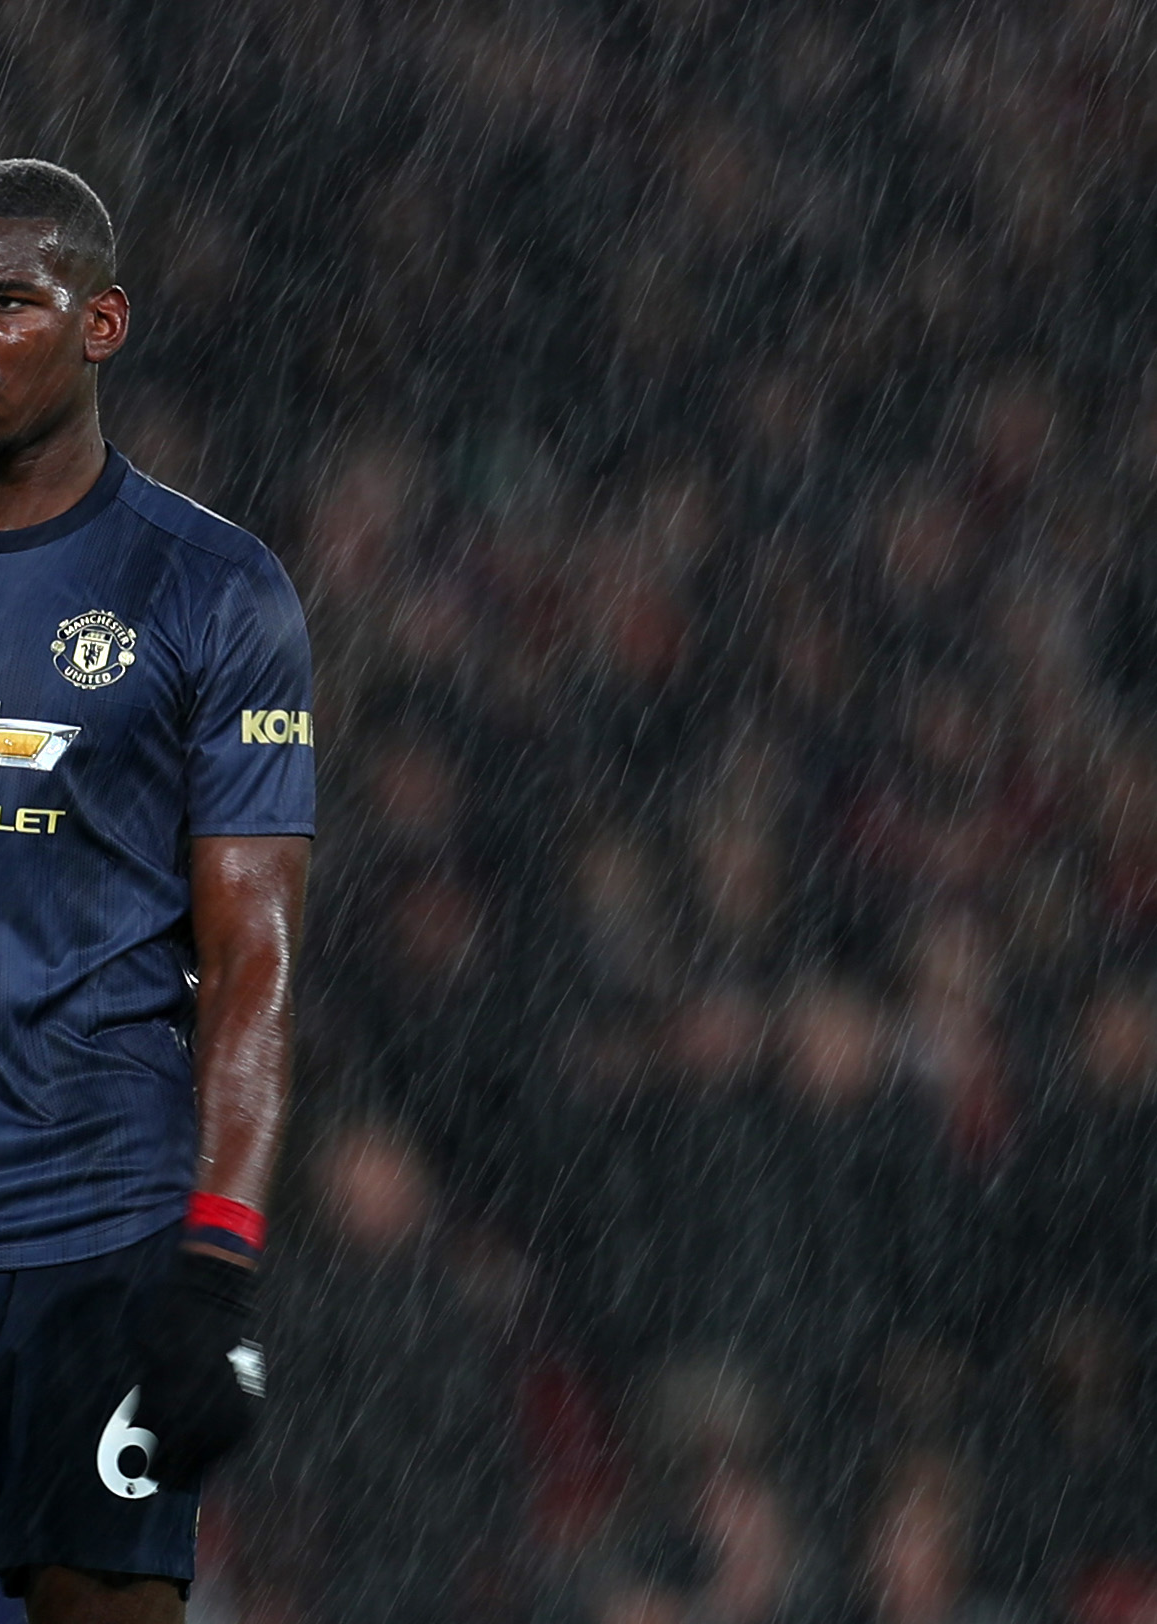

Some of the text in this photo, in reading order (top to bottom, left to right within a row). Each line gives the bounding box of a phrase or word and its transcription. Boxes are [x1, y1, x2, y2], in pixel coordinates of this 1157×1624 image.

[64, 614, 129, 645] MANCHESTER
[64, 666, 111, 684] UNITED
[242, 709, 313, 747] KOH
[97, 1384, 160, 1500] 6
